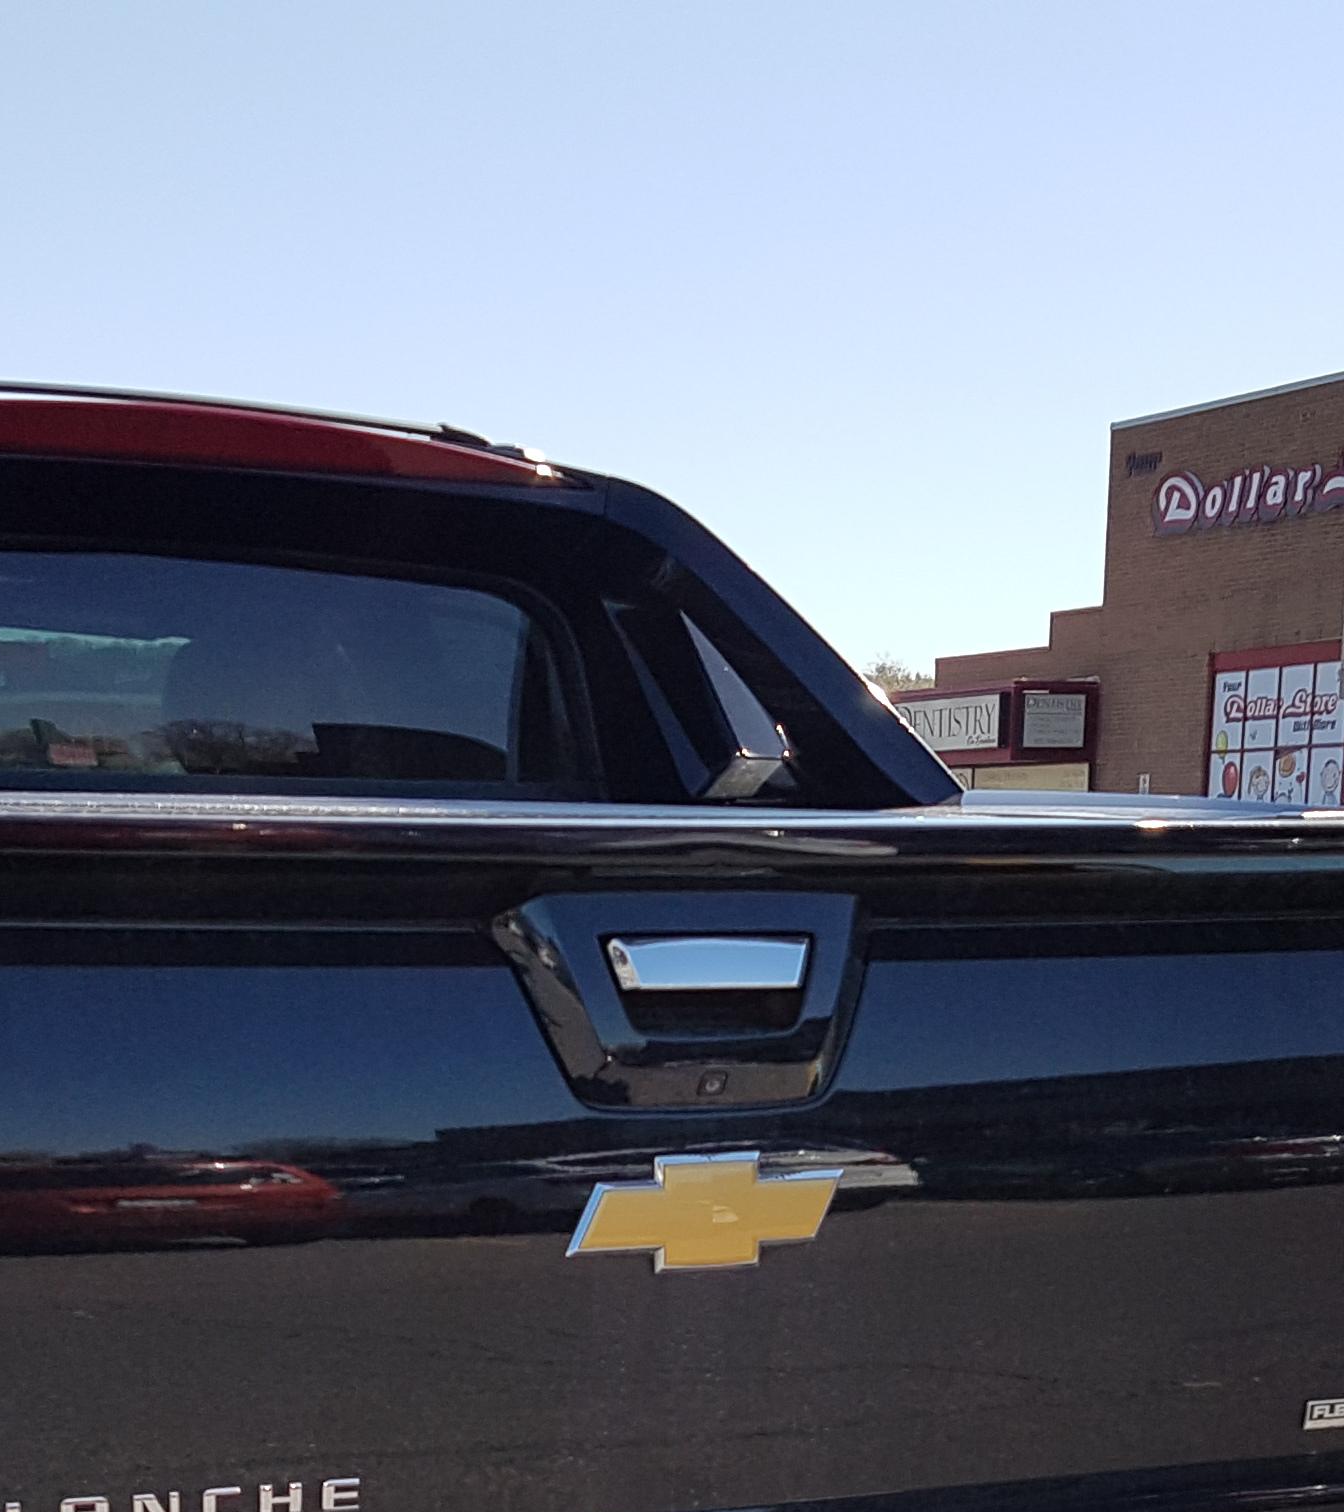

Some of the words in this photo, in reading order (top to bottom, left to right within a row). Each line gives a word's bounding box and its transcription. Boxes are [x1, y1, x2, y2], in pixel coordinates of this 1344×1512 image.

[1156, 466, 1318, 532] Dollar
[1222, 681, 1242, 693] Your
[1224, 694, 1283, 723] Dollar
[1282, 688, 1338, 719] Store
